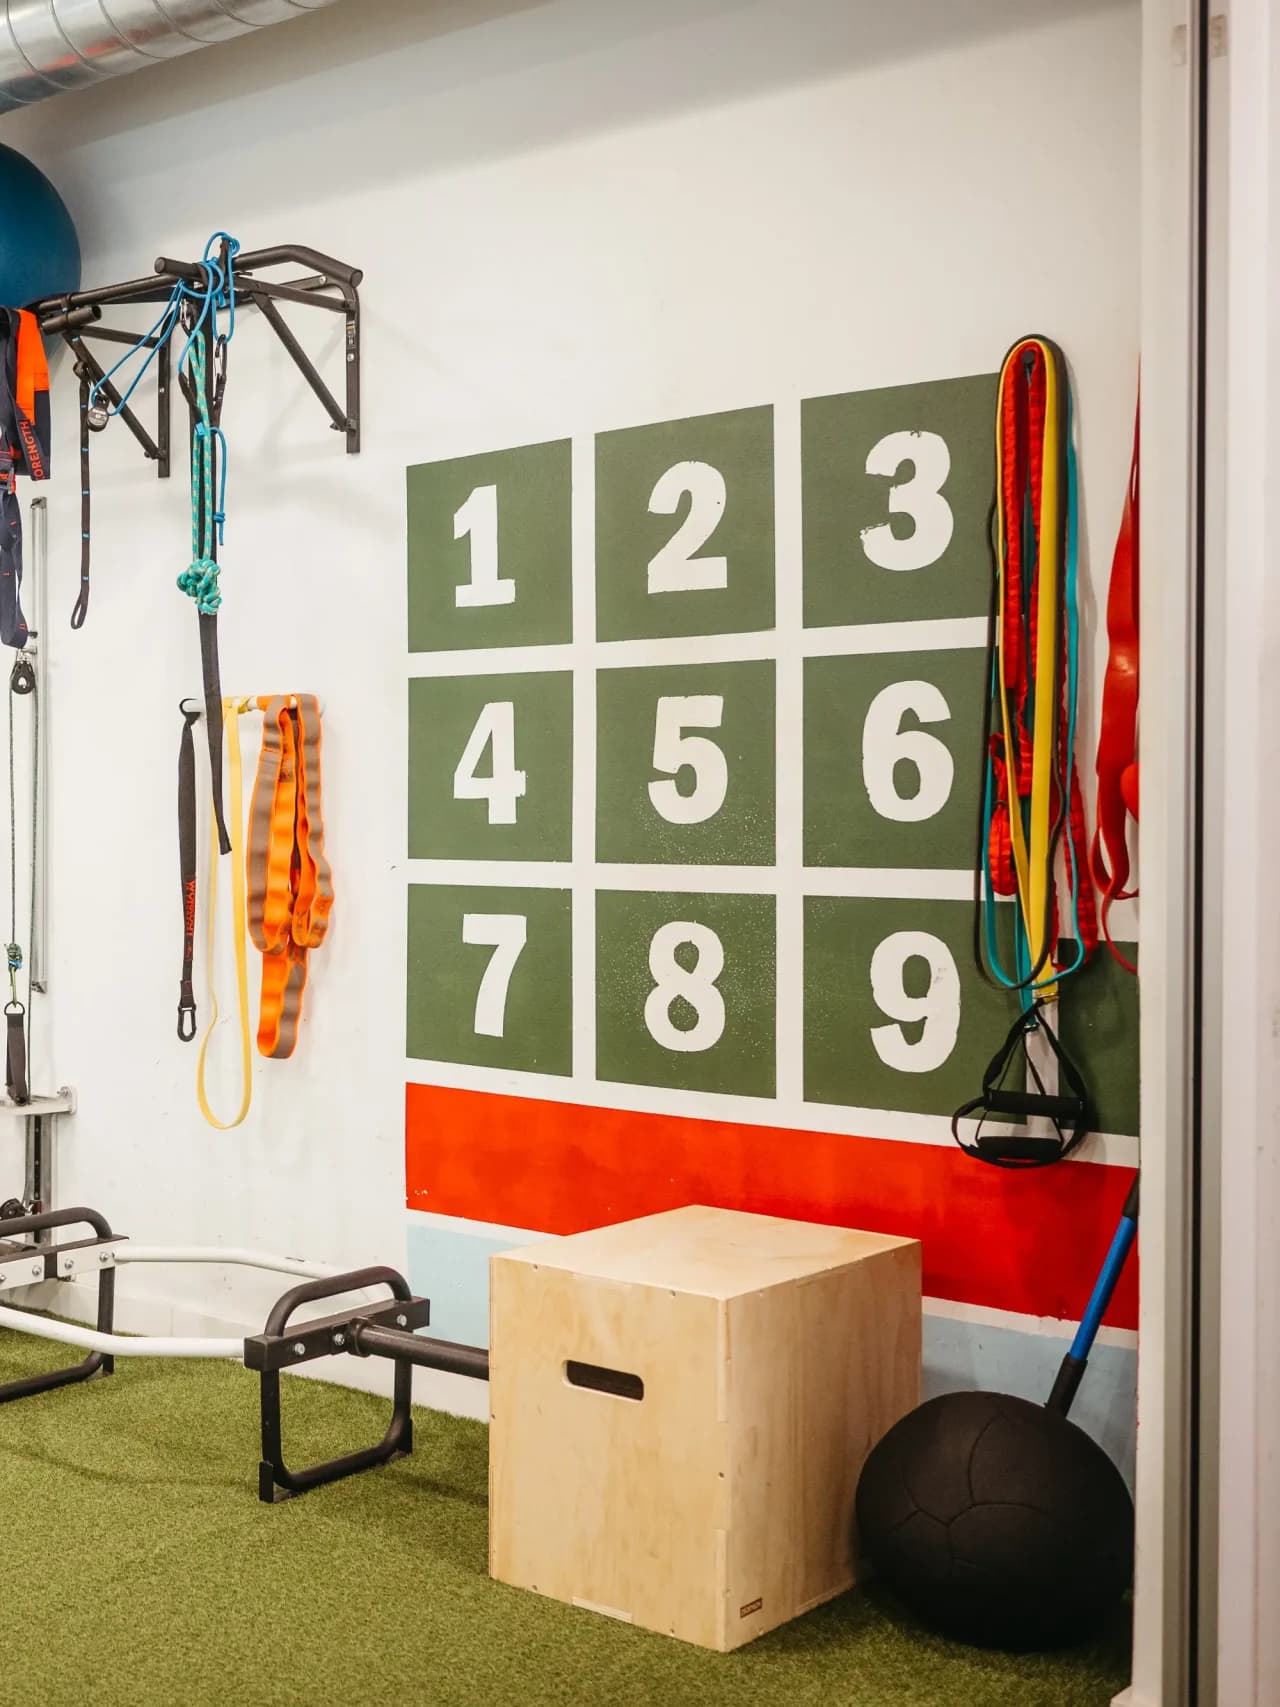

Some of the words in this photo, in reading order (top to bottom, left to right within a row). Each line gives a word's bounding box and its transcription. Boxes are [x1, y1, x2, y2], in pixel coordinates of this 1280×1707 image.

[20, 421, 45, 480] ORENGTH
[454, 484, 515, 607] 1
[648, 461, 727, 594] 2
[860, 431, 953, 571] 3
[454, 702, 526, 824] 4
[648, 695, 728, 824] 5
[863, 681, 953, 821] 6
[463, 914, 527, 1037] 7
[645, 921, 725, 1051] 8
[871, 932, 960, 1072] 9
